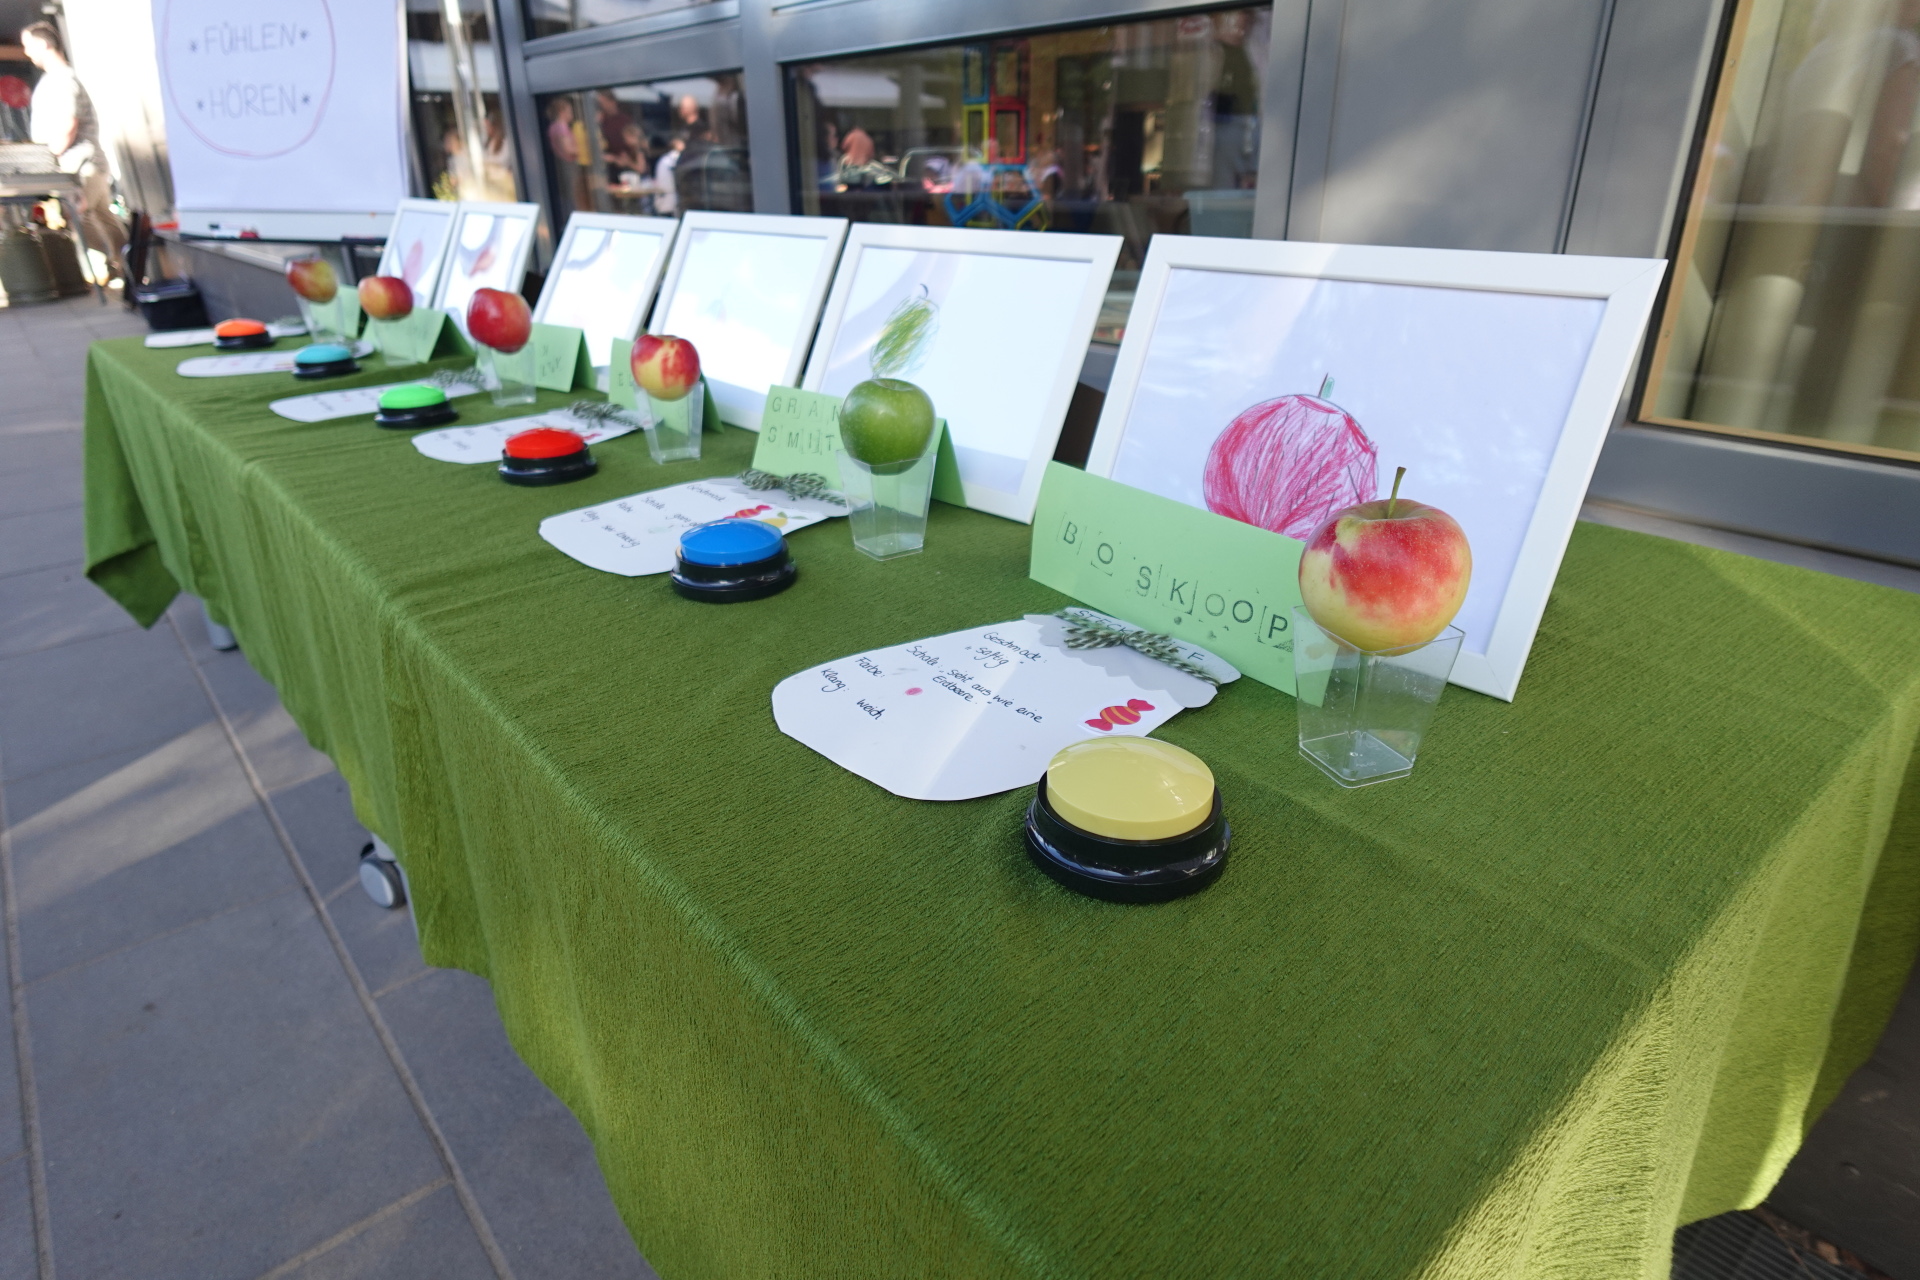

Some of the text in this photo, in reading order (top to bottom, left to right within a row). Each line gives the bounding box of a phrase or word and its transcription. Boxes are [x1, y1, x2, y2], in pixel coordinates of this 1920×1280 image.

[203, 21, 298, 55] FÜHLEN
[208, 81, 298, 119] HÖREN
[771, 396, 843, 422] GRAN
[767, 426, 836, 452] SMIT
[1062, 520, 1289, 639] BOSKOOP
[971, 683, 992, 697] aus
[993, 694, 1014, 708] wie
[1015, 707, 1043, 724] eine
